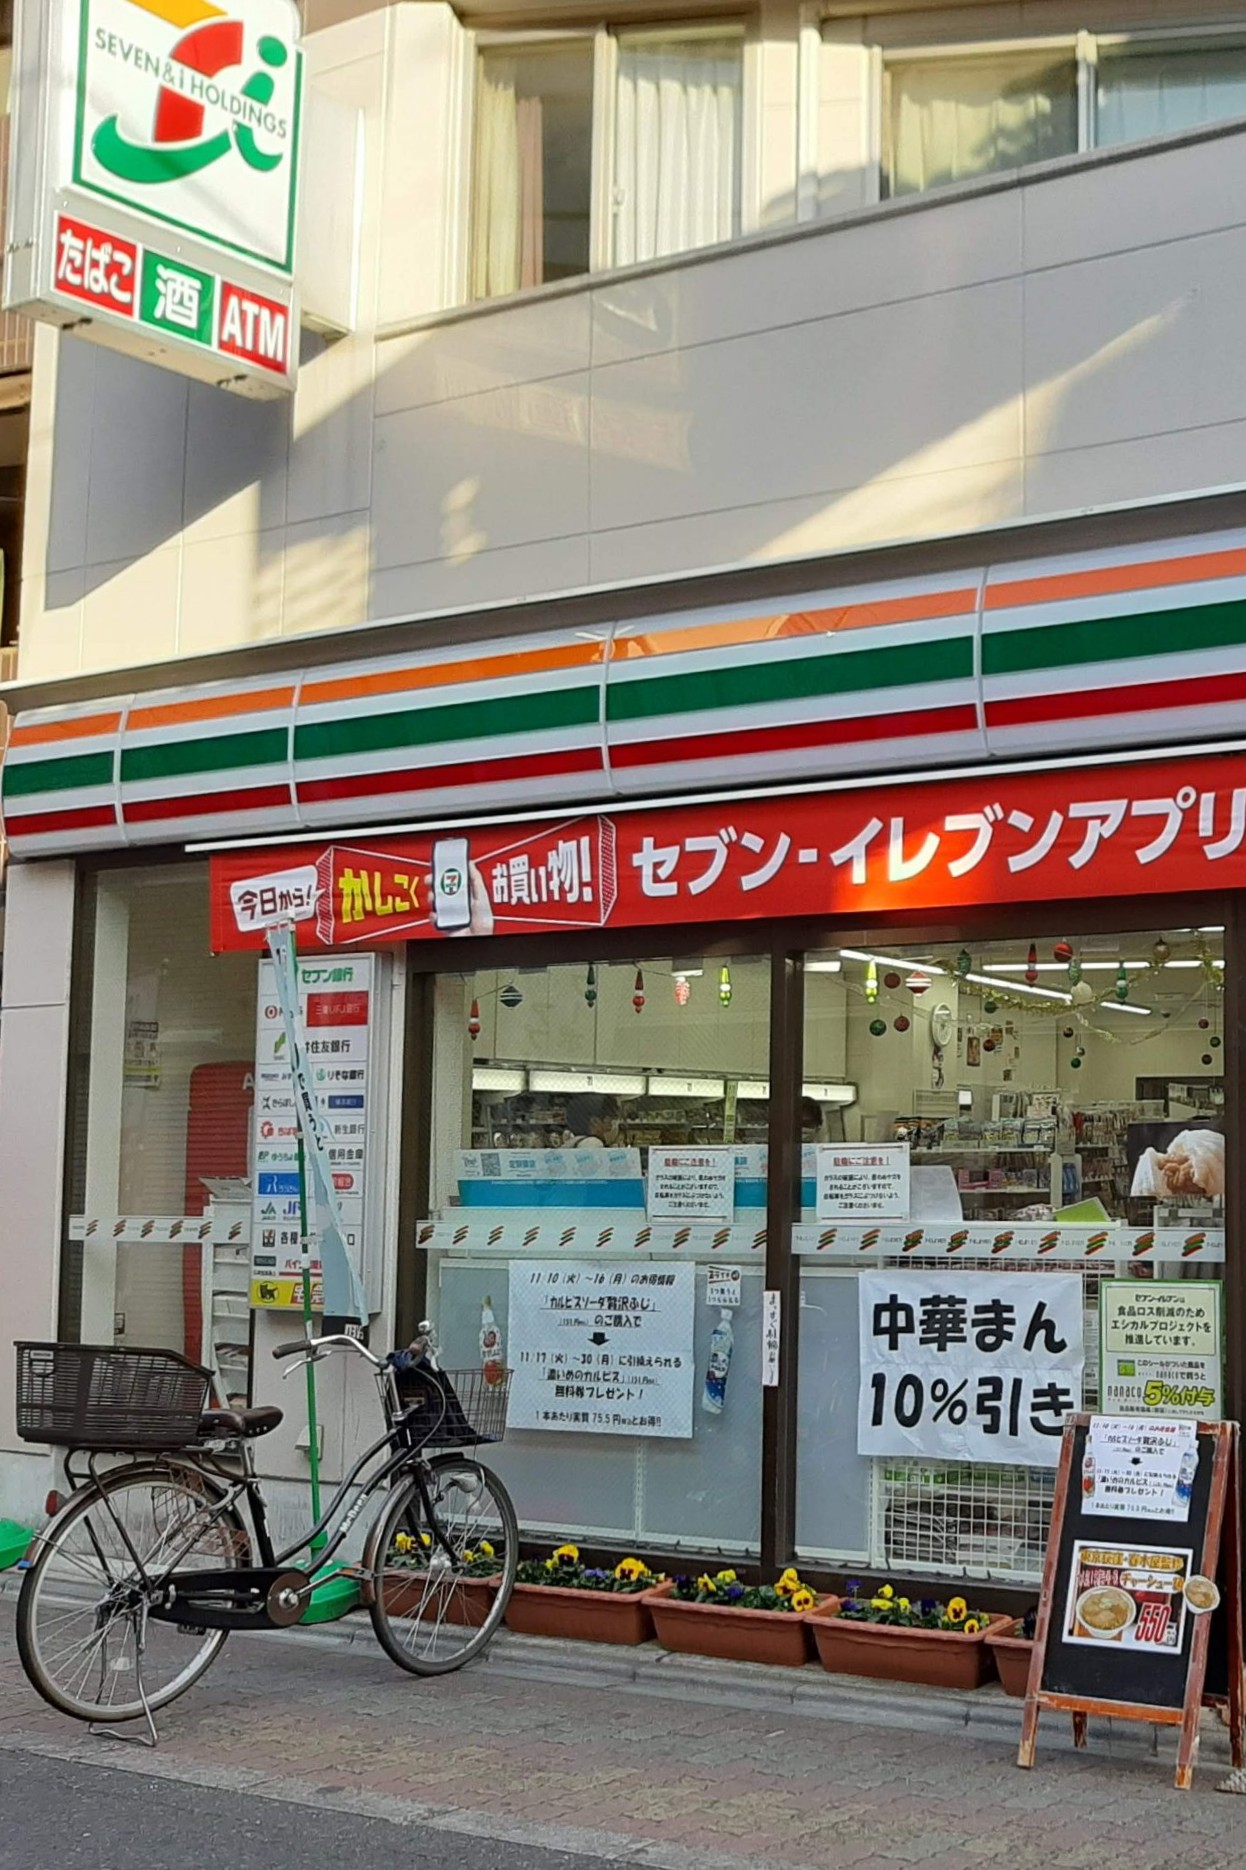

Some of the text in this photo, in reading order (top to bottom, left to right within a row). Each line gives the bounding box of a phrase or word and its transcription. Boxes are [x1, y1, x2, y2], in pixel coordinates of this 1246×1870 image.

[190, 78, 288, 139] HOLDINGS
[58, 228, 287, 361] たばこ 酒 ATM
[338, 868, 420, 923] かしこく
[872, 1294, 1068, 1354] 中華まん
[1111, 1320, 1212, 1334] エシカルプロジェクトを
[1118, 1305, 1206, 1318] 食品ロス削減のため
[871, 1372, 1075, 1438] 10%引き
[1135, 1602, 1171, 1642] 550
